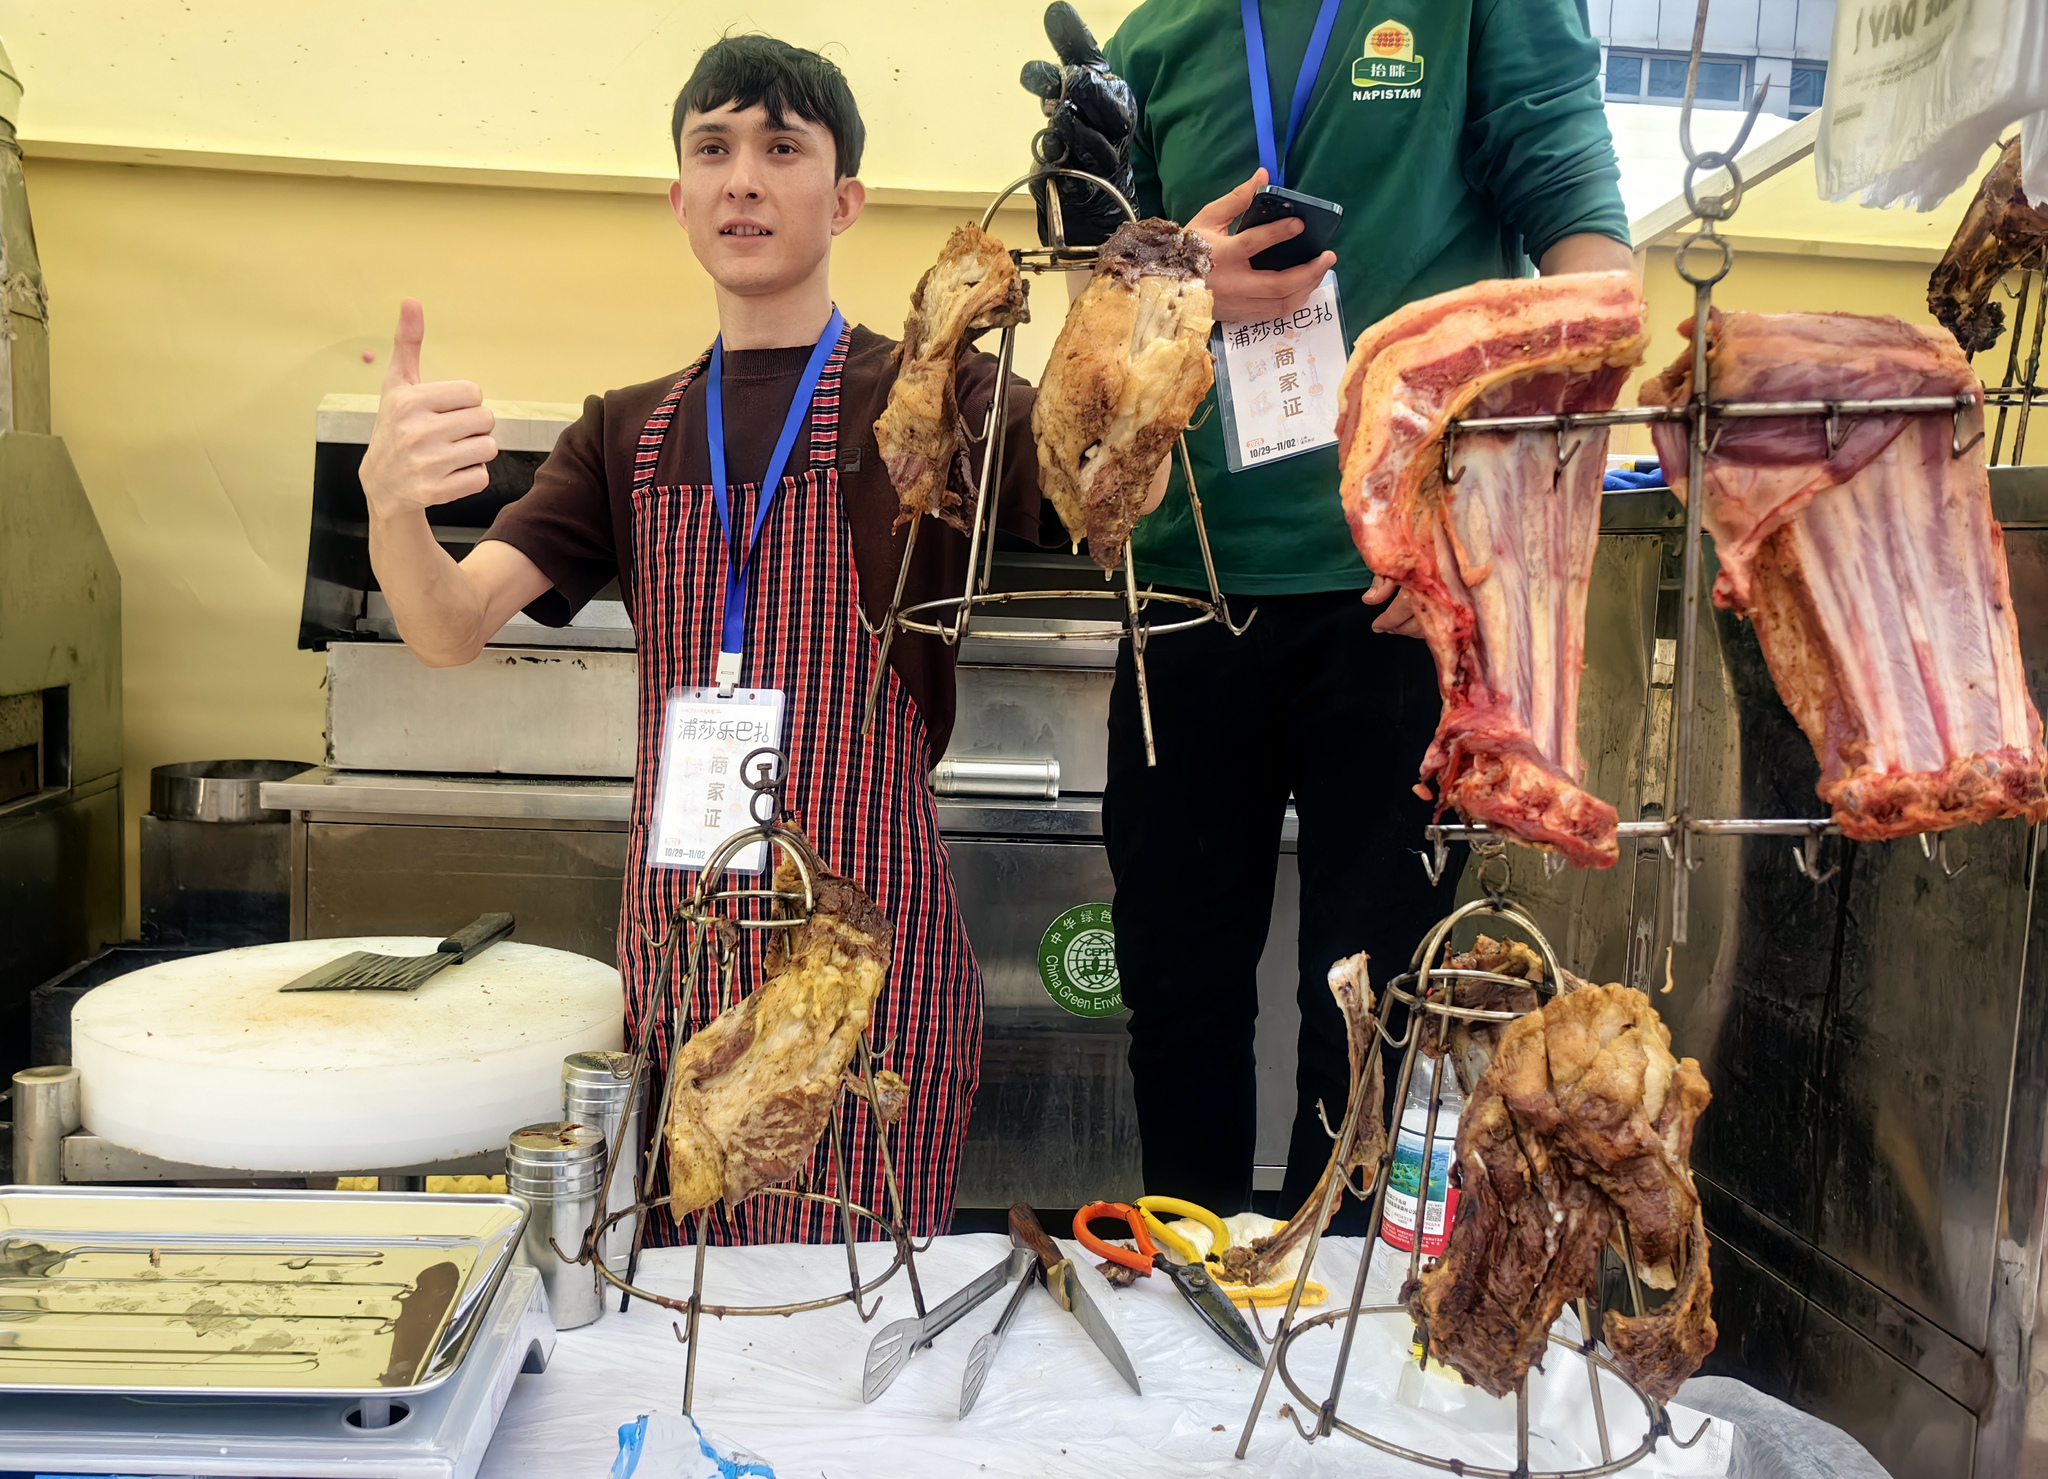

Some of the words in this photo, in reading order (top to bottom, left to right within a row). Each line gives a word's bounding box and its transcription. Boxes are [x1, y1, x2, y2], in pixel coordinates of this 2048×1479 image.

[1352, 89, 1421, 101] NAPISTAM
[1275, 347, 1304, 418] 商家证
[704, 755, 729, 829] 商家证
[1050, 909, 1112, 945] 中华绿色
[1045, 955, 1062, 989] China
[1059, 985, 1091, 1010] Green
